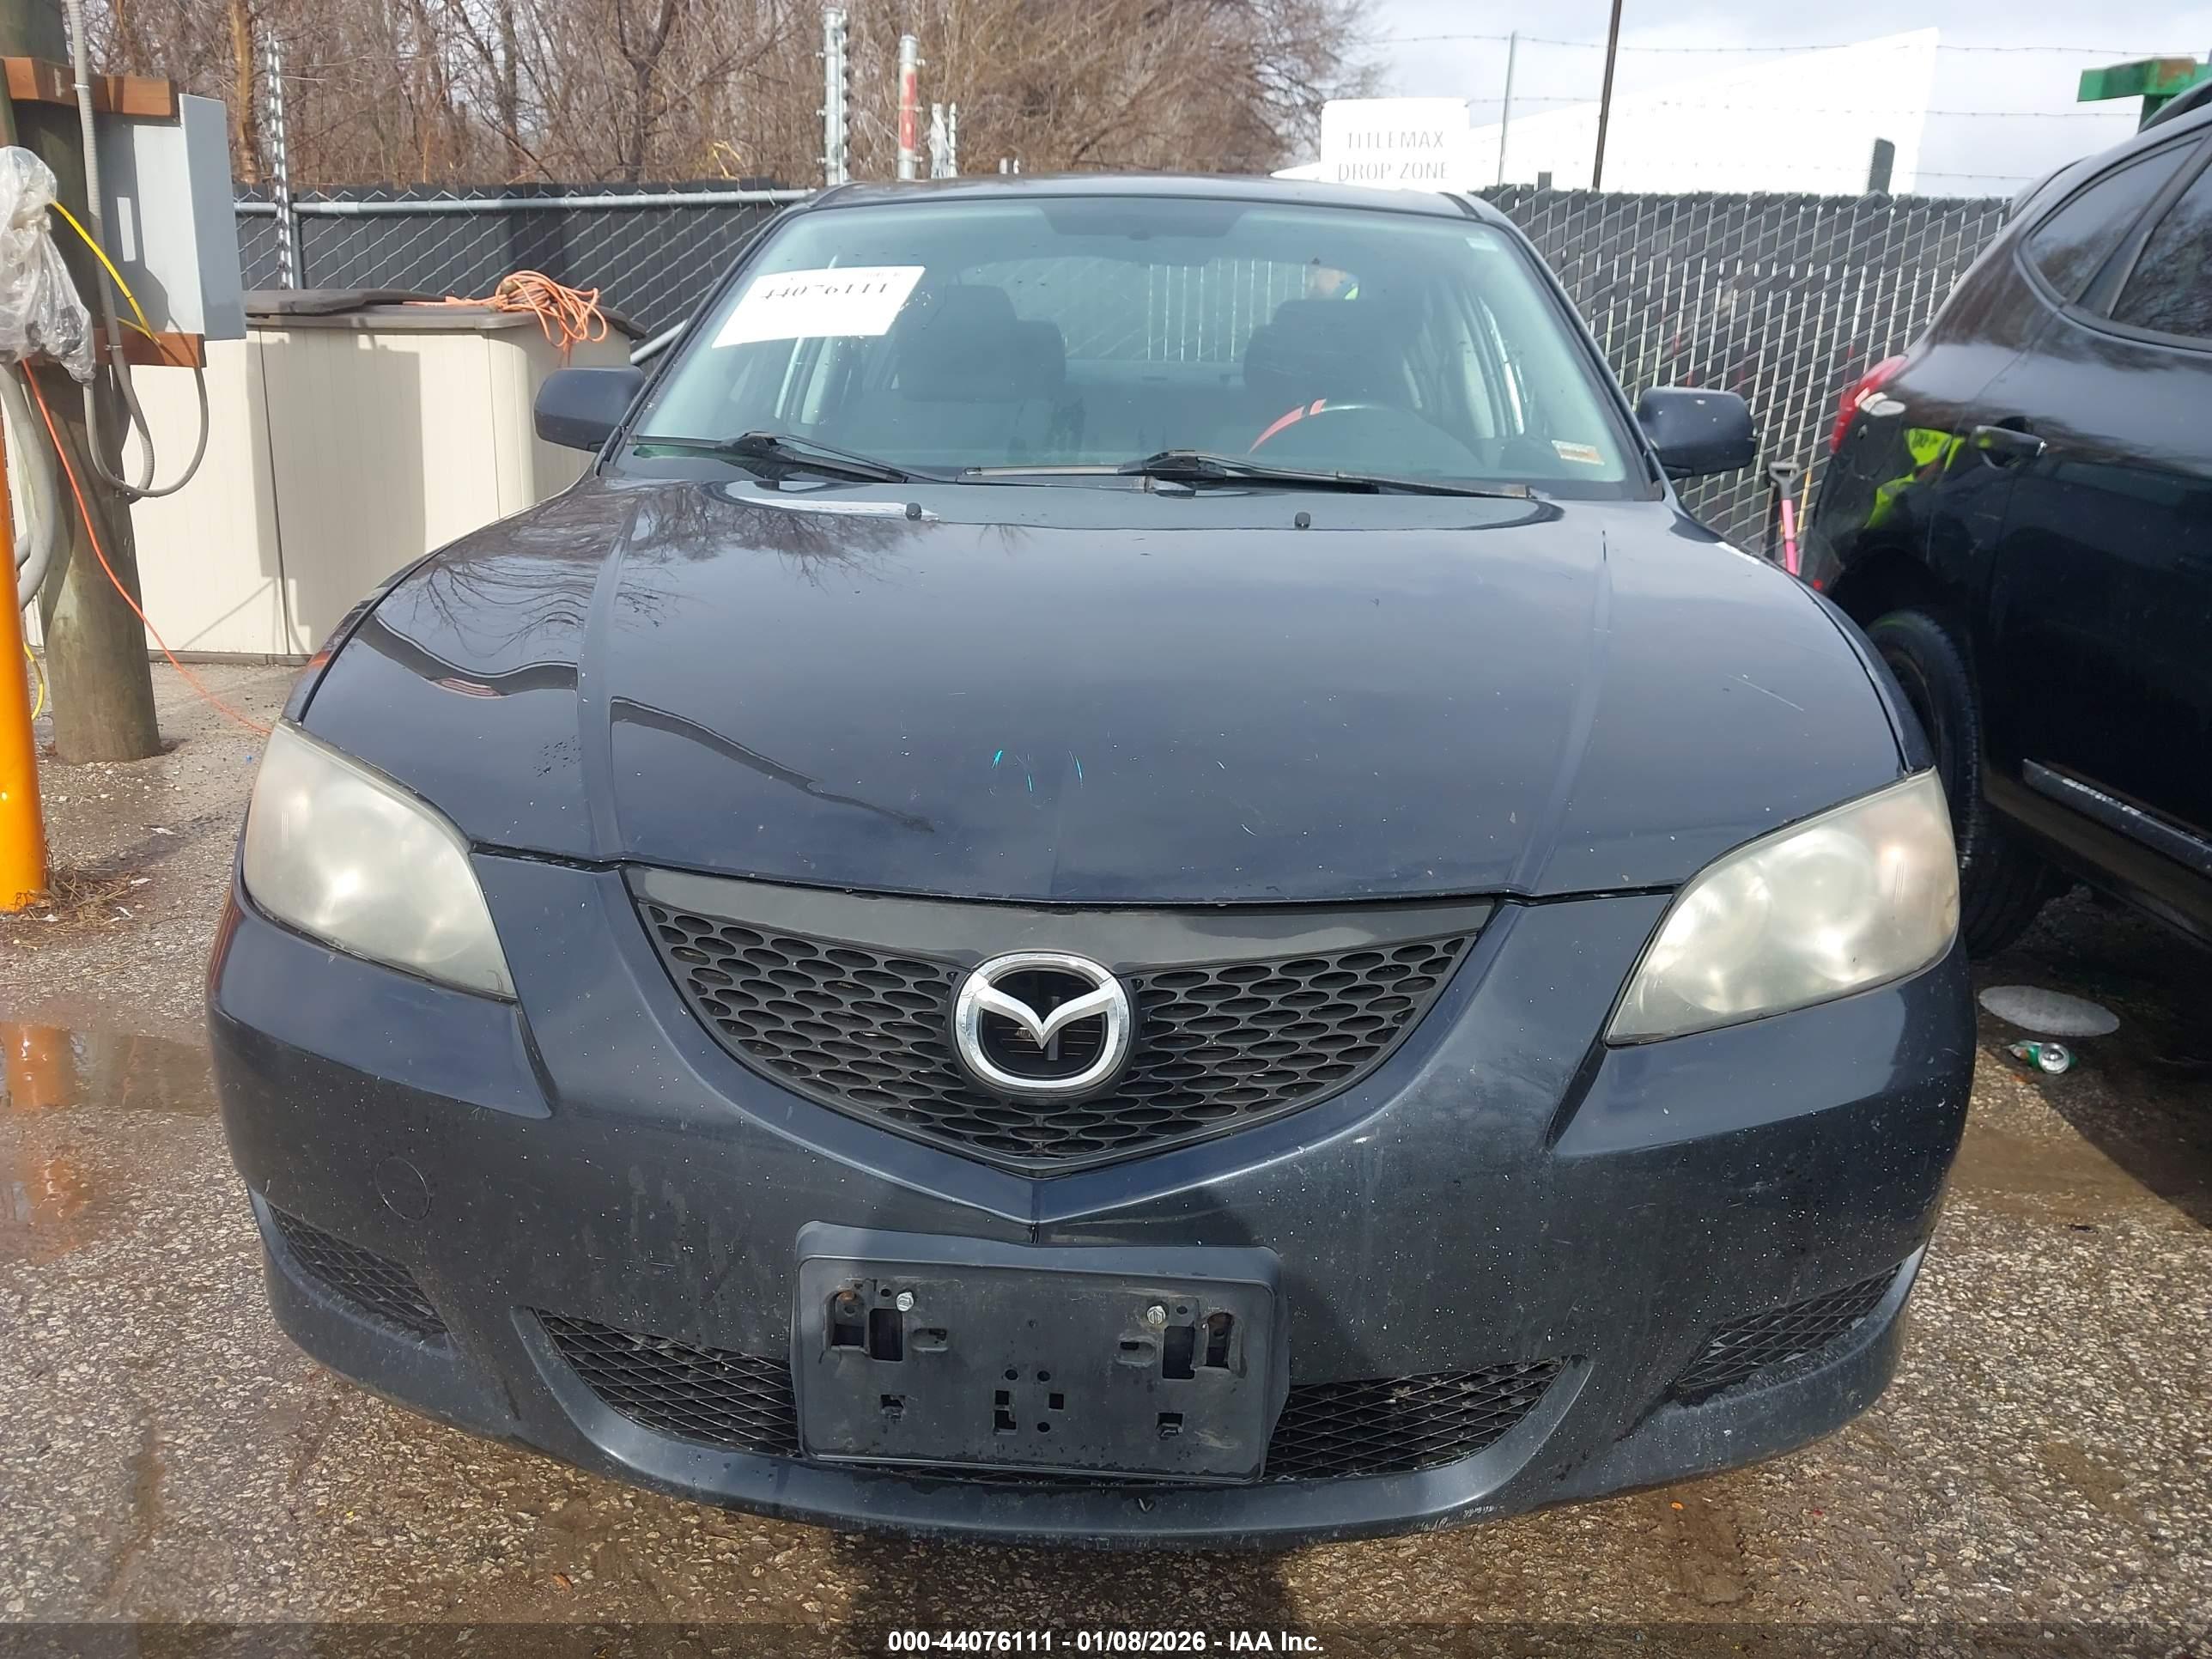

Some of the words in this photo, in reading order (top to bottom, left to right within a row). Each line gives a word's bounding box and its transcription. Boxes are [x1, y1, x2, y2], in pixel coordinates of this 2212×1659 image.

[1347, 131, 1443, 149] TITLEMAX
[1338, 162, 1391, 182] DROP
[1400, 161, 1449, 180] ZONE
